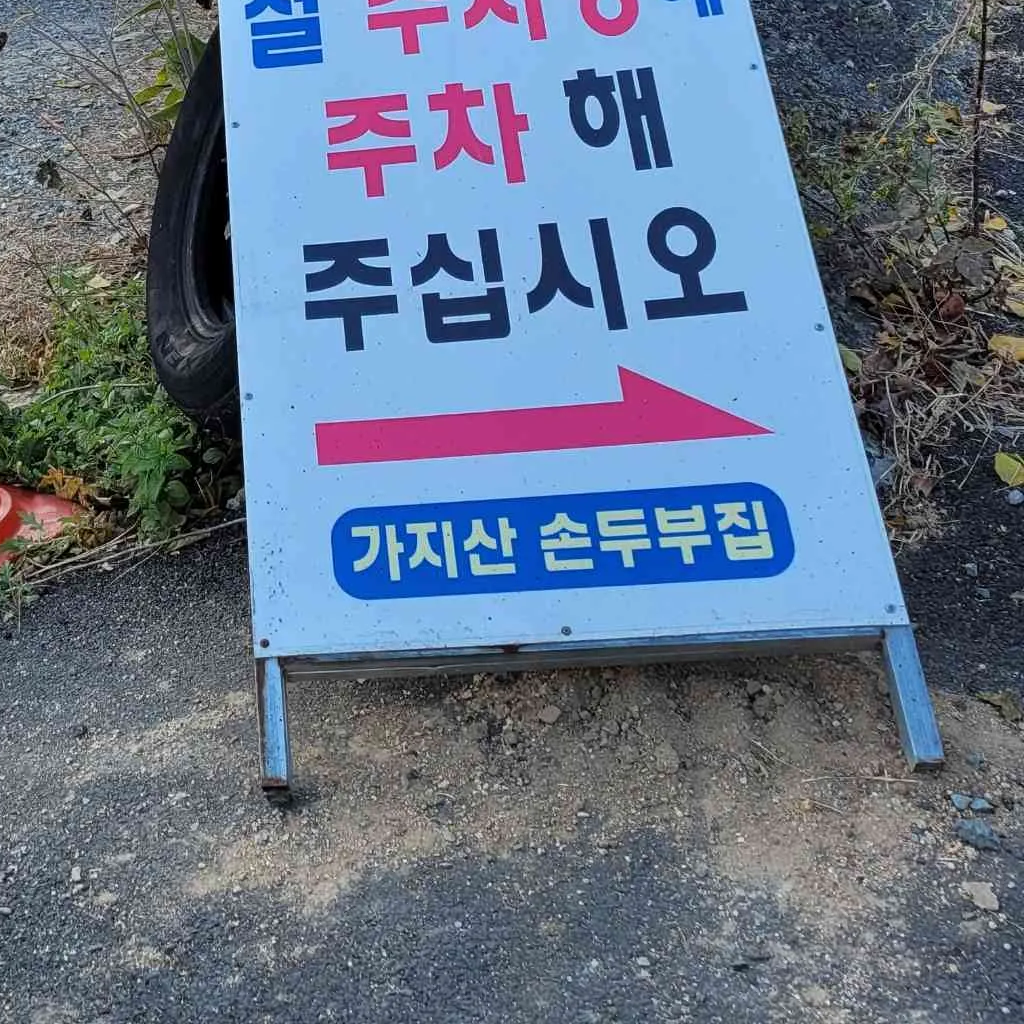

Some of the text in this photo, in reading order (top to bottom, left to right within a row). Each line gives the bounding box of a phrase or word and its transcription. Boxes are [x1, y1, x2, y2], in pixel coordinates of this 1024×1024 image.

[325, 67, 673, 198] 주차 해
[303, 207, 748, 352] 주십시오
[352, 501, 774, 581] 가지산 손두부집
